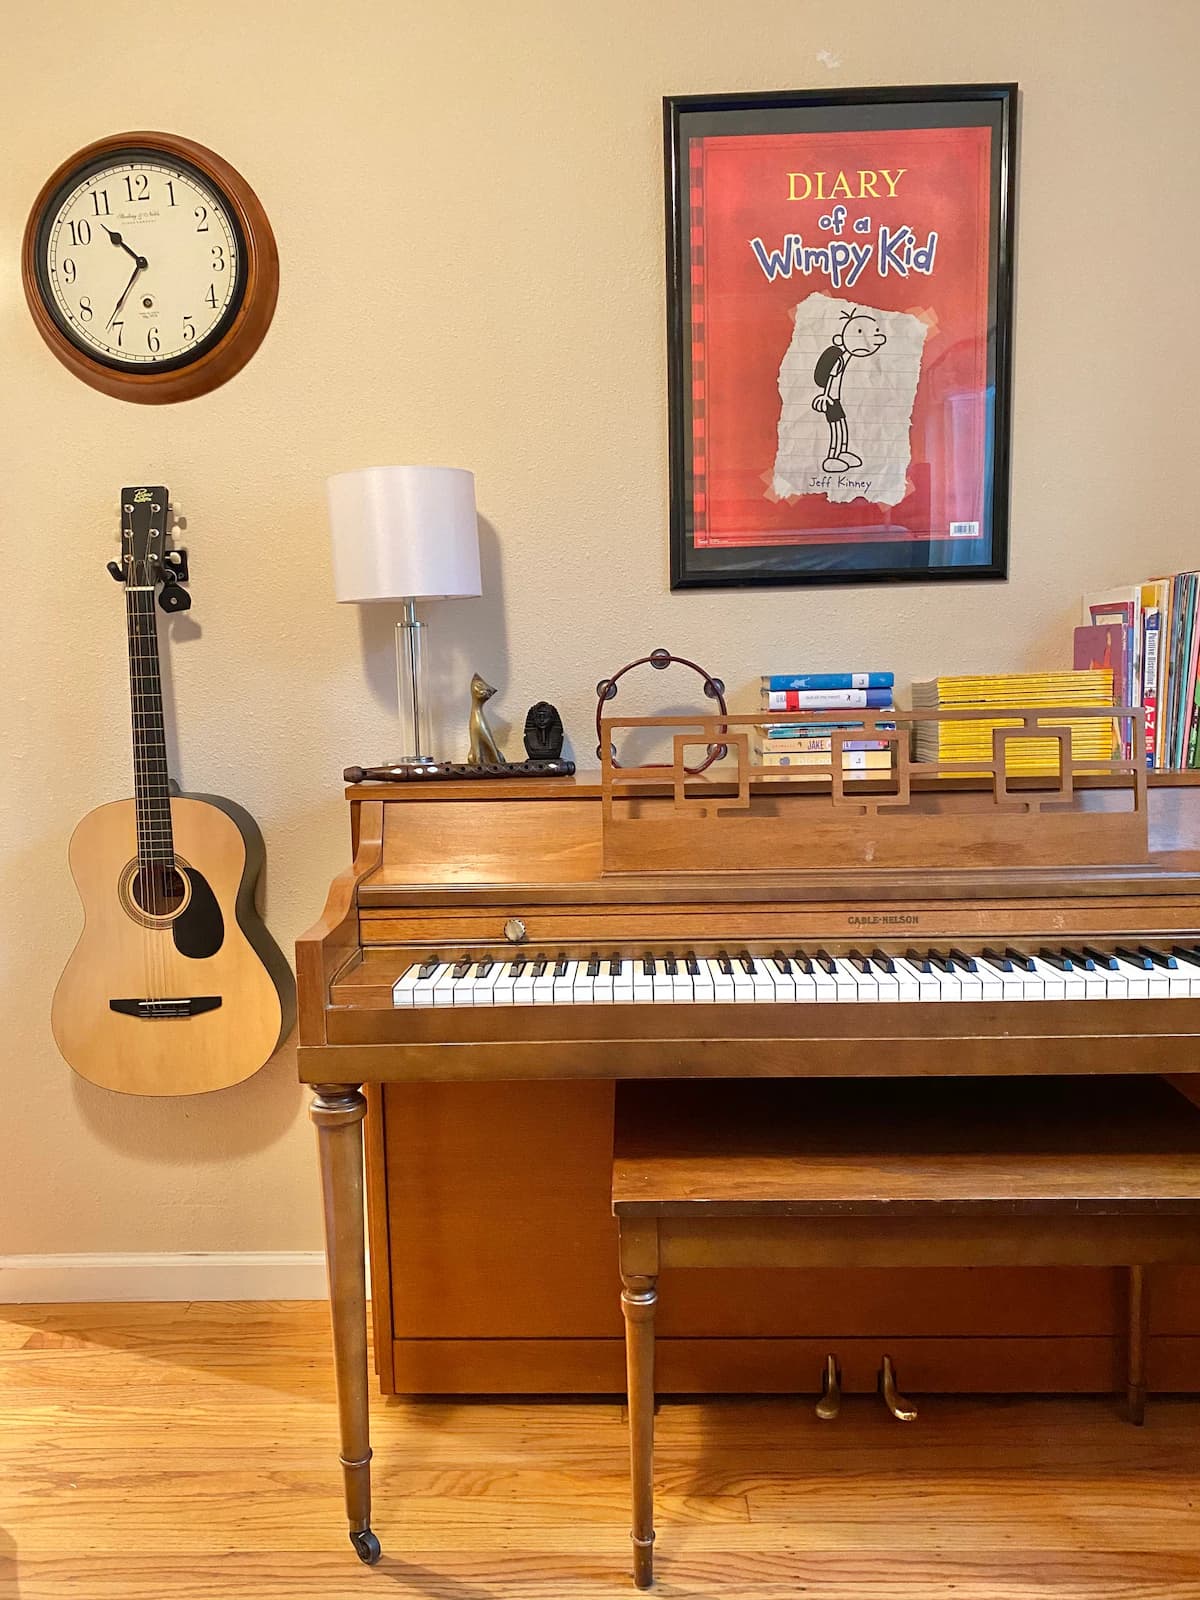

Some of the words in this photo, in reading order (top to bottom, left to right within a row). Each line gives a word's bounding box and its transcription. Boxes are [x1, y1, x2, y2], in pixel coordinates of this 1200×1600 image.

[123, 174, 150, 202] 12
[165, 181, 180, 207] 1
[786, 169, 907, 200] DIARY
[89, 190, 113, 216] 11
[194, 206, 209, 232] 2
[818, 205, 847, 235] of
[853, 216, 871, 233] a
[67, 219, 91, 246] 10
[211, 246, 225, 271] 3
[750, 234, 873, 288] Wimpy
[878, 225, 938, 277] Kid
[63, 258, 77, 284] 9
[79, 296, 93, 322] 8
[204, 283, 219, 309] 4
[112, 321, 124, 346] 7
[147, 327, 160, 353] 6
[183, 315, 196, 341] 5
[809, 476, 832, 488] Jeff
[837, 476, 872, 494] Kinney
[1145, 705, 1155, 730] A-Z
[807, 739, 825, 750] JAKE
